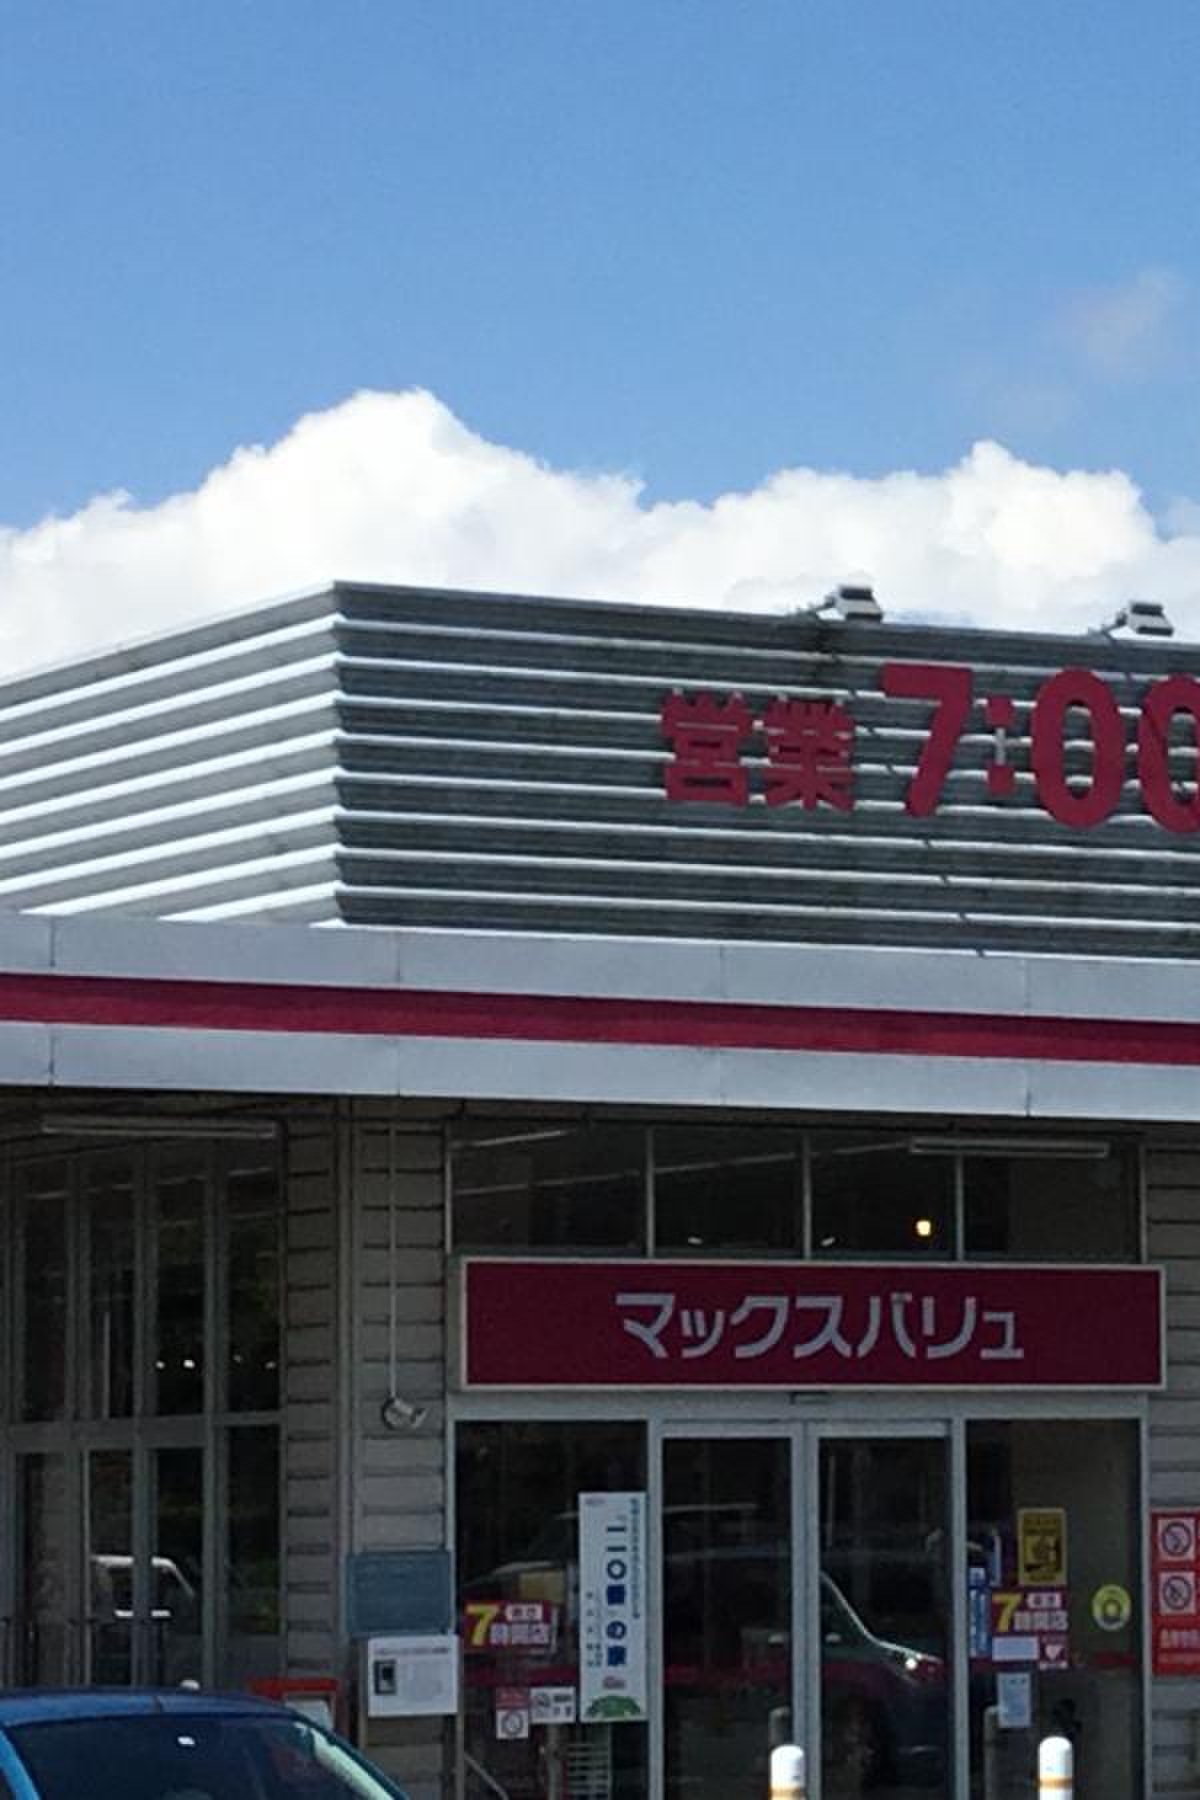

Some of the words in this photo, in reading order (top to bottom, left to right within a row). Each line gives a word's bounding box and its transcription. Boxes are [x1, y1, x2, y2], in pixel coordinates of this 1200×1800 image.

[660, 690, 854, 809] 営業
[615, 1292, 1024, 1359] マックスバリュ
